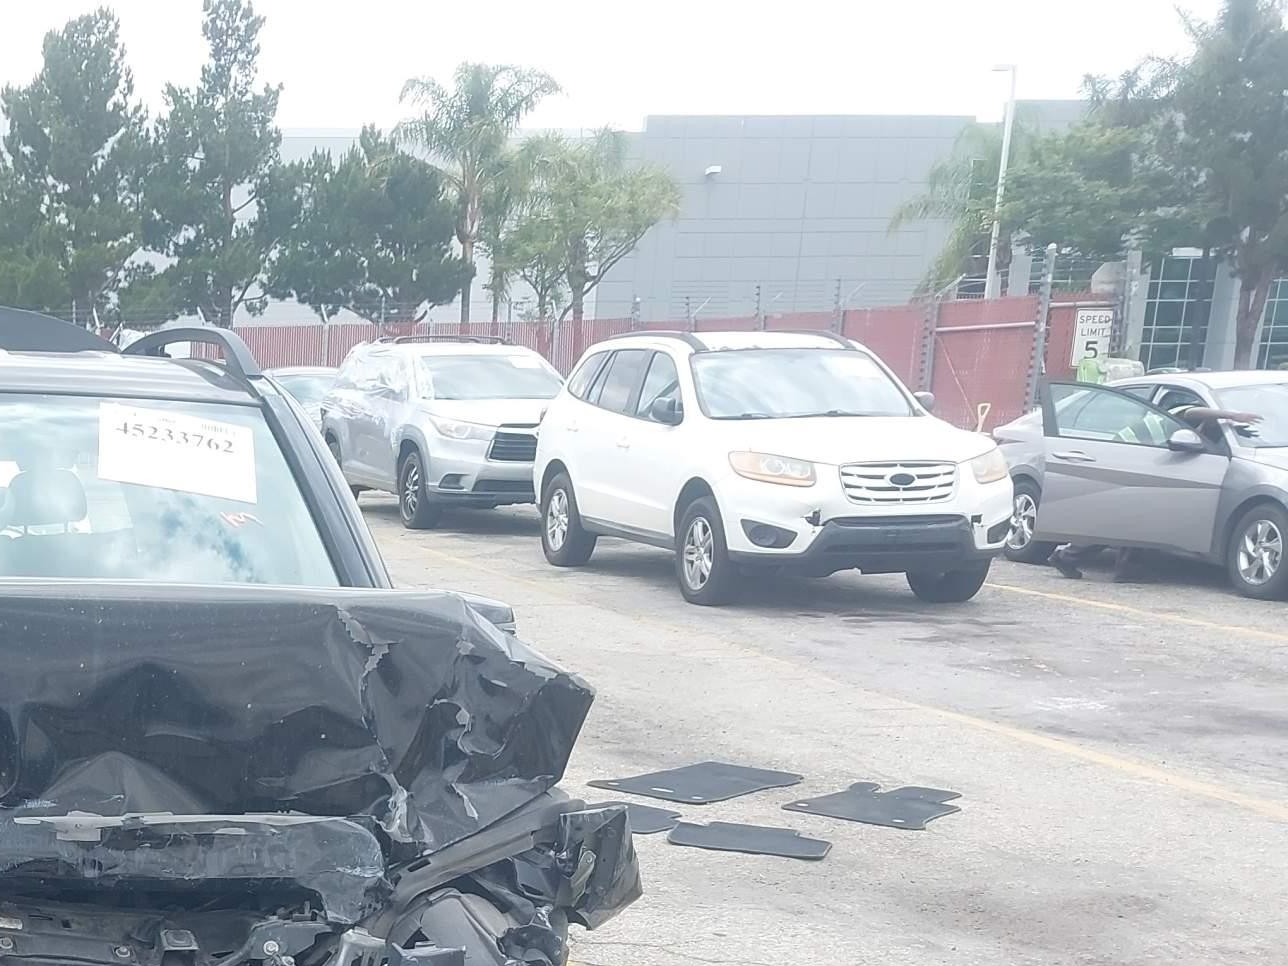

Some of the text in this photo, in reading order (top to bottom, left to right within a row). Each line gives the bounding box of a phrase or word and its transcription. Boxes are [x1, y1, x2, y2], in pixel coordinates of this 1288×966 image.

[1079, 314, 1111, 324] SPEED
[1080, 327, 1106, 337] LIMIT
[1083, 340, 1098, 359] 5
[116, 421, 235, 454] 45233762
